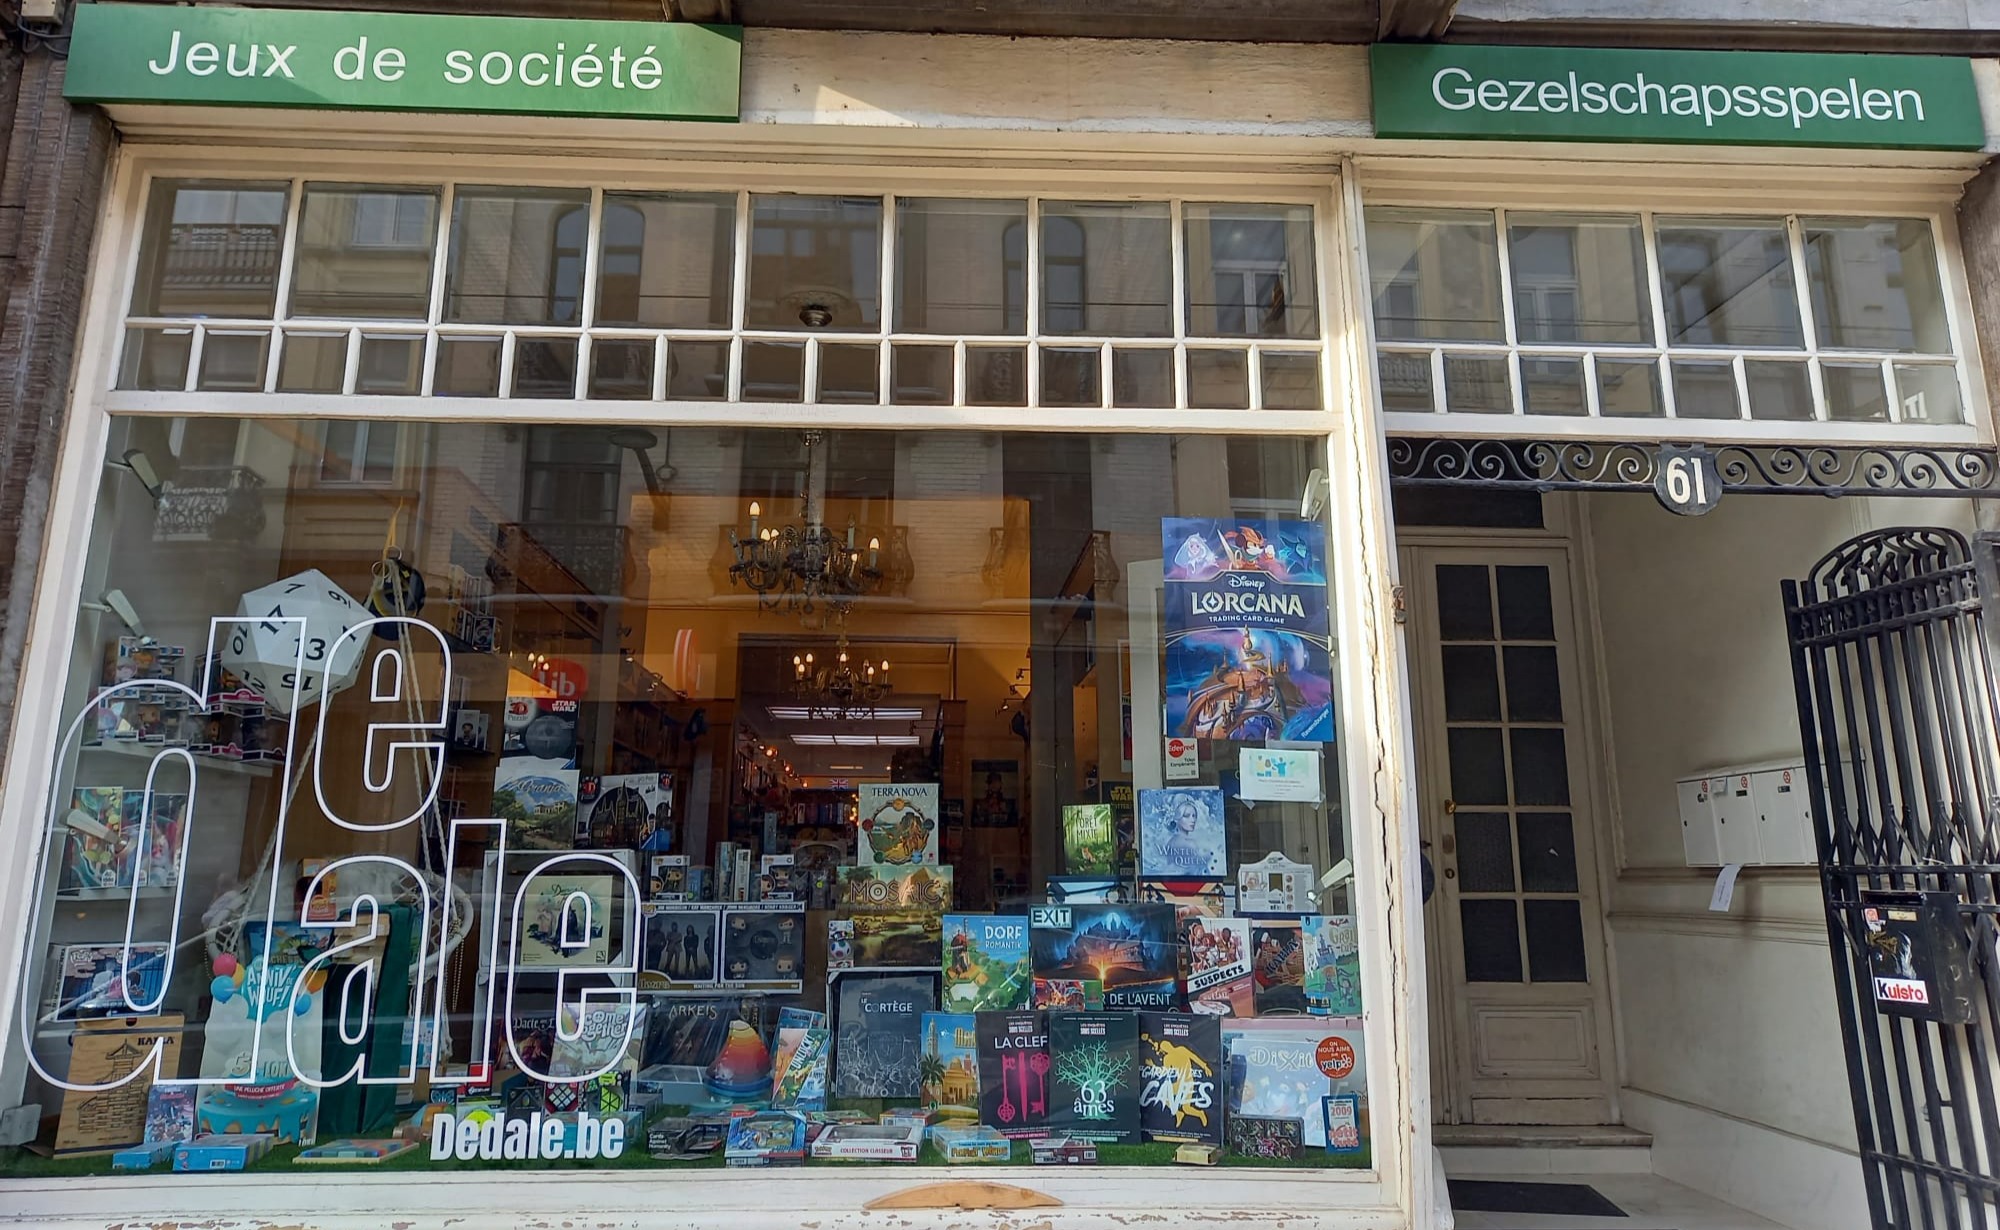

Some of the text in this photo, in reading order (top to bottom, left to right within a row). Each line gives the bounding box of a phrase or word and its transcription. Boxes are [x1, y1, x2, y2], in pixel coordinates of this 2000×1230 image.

[149, 30, 664, 91] Jeux de société
[1430, 67, 1925, 128] Gezelschapsspelen
[1666, 456, 1707, 504] 61
[1226, 574, 1265, 591] Disney
[1191, 590, 1305, 618] LORCANA
[259, 604, 288, 635] 17
[1208, 615, 1241, 623] TRADING
[1264, 616, 1285, 624] GAME
[232, 625, 248, 655] 10
[294, 638, 326, 661] 13
[1301, 708, 1329, 739] Ravensburger
[872, 787, 927, 797] TERRA NOVA
[850, 879, 941, 903] MOSAIC
[1033, 909, 1071, 924] EXIT
[985, 925, 1022, 940] DORF
[985, 941, 1022, 950] ROMANTIK
[1194, 965, 1244, 989] SUSPECTS
[864, 1000, 913, 1013] CORTÈGE
[1110, 993, 1123, 1005] DE
[1127, 993, 1172, 1006] L'AVENT
[669, 1004, 718, 1020] ARKEIS
[994, 1036, 1048, 1049] LA CLEF
[1320, 1058, 1342, 1072] yelp
[1080, 1080, 1107, 1104] 63
[1140, 1080, 1214, 1116] CAVES
[1073, 1098, 1115, 1117] âmes
[1330, 1106, 1353, 1117] 2009
[430, 1111, 625, 1160] Dedale.be
